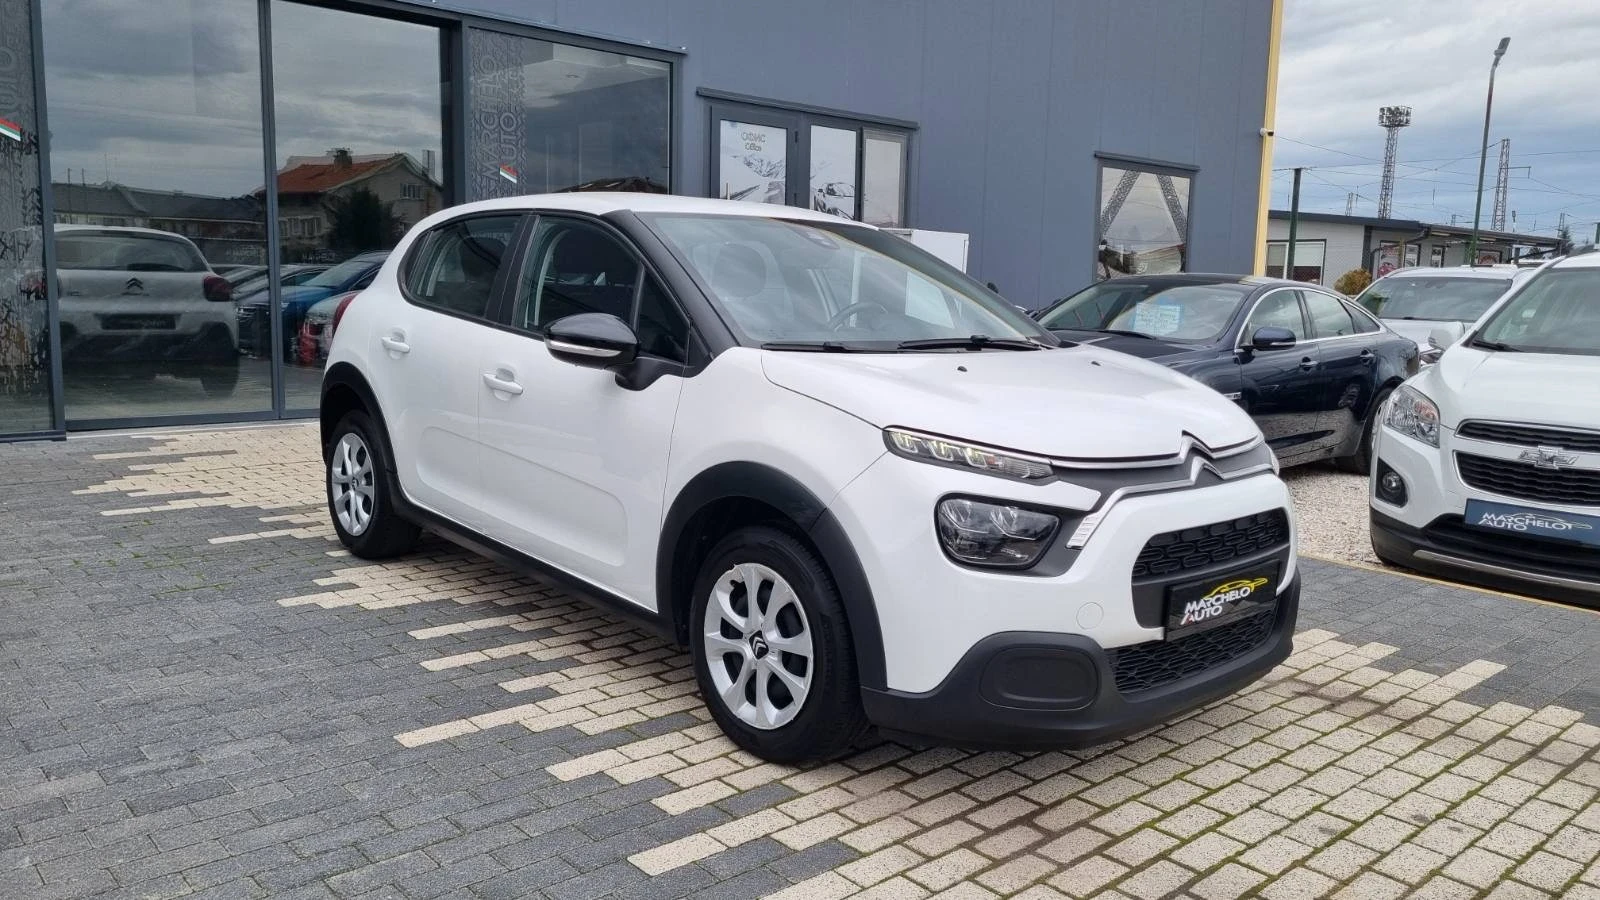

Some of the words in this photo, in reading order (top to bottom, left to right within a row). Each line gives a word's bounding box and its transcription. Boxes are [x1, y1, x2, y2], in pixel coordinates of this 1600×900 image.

[479, 55, 498, 180] MARCHELO
[498, 112, 519, 184] AUTO
[1478, 519, 1528, 531] AUTO
[1184, 586, 1251, 614] MARCHELO
[1180, 605, 1223, 625] AUTO
